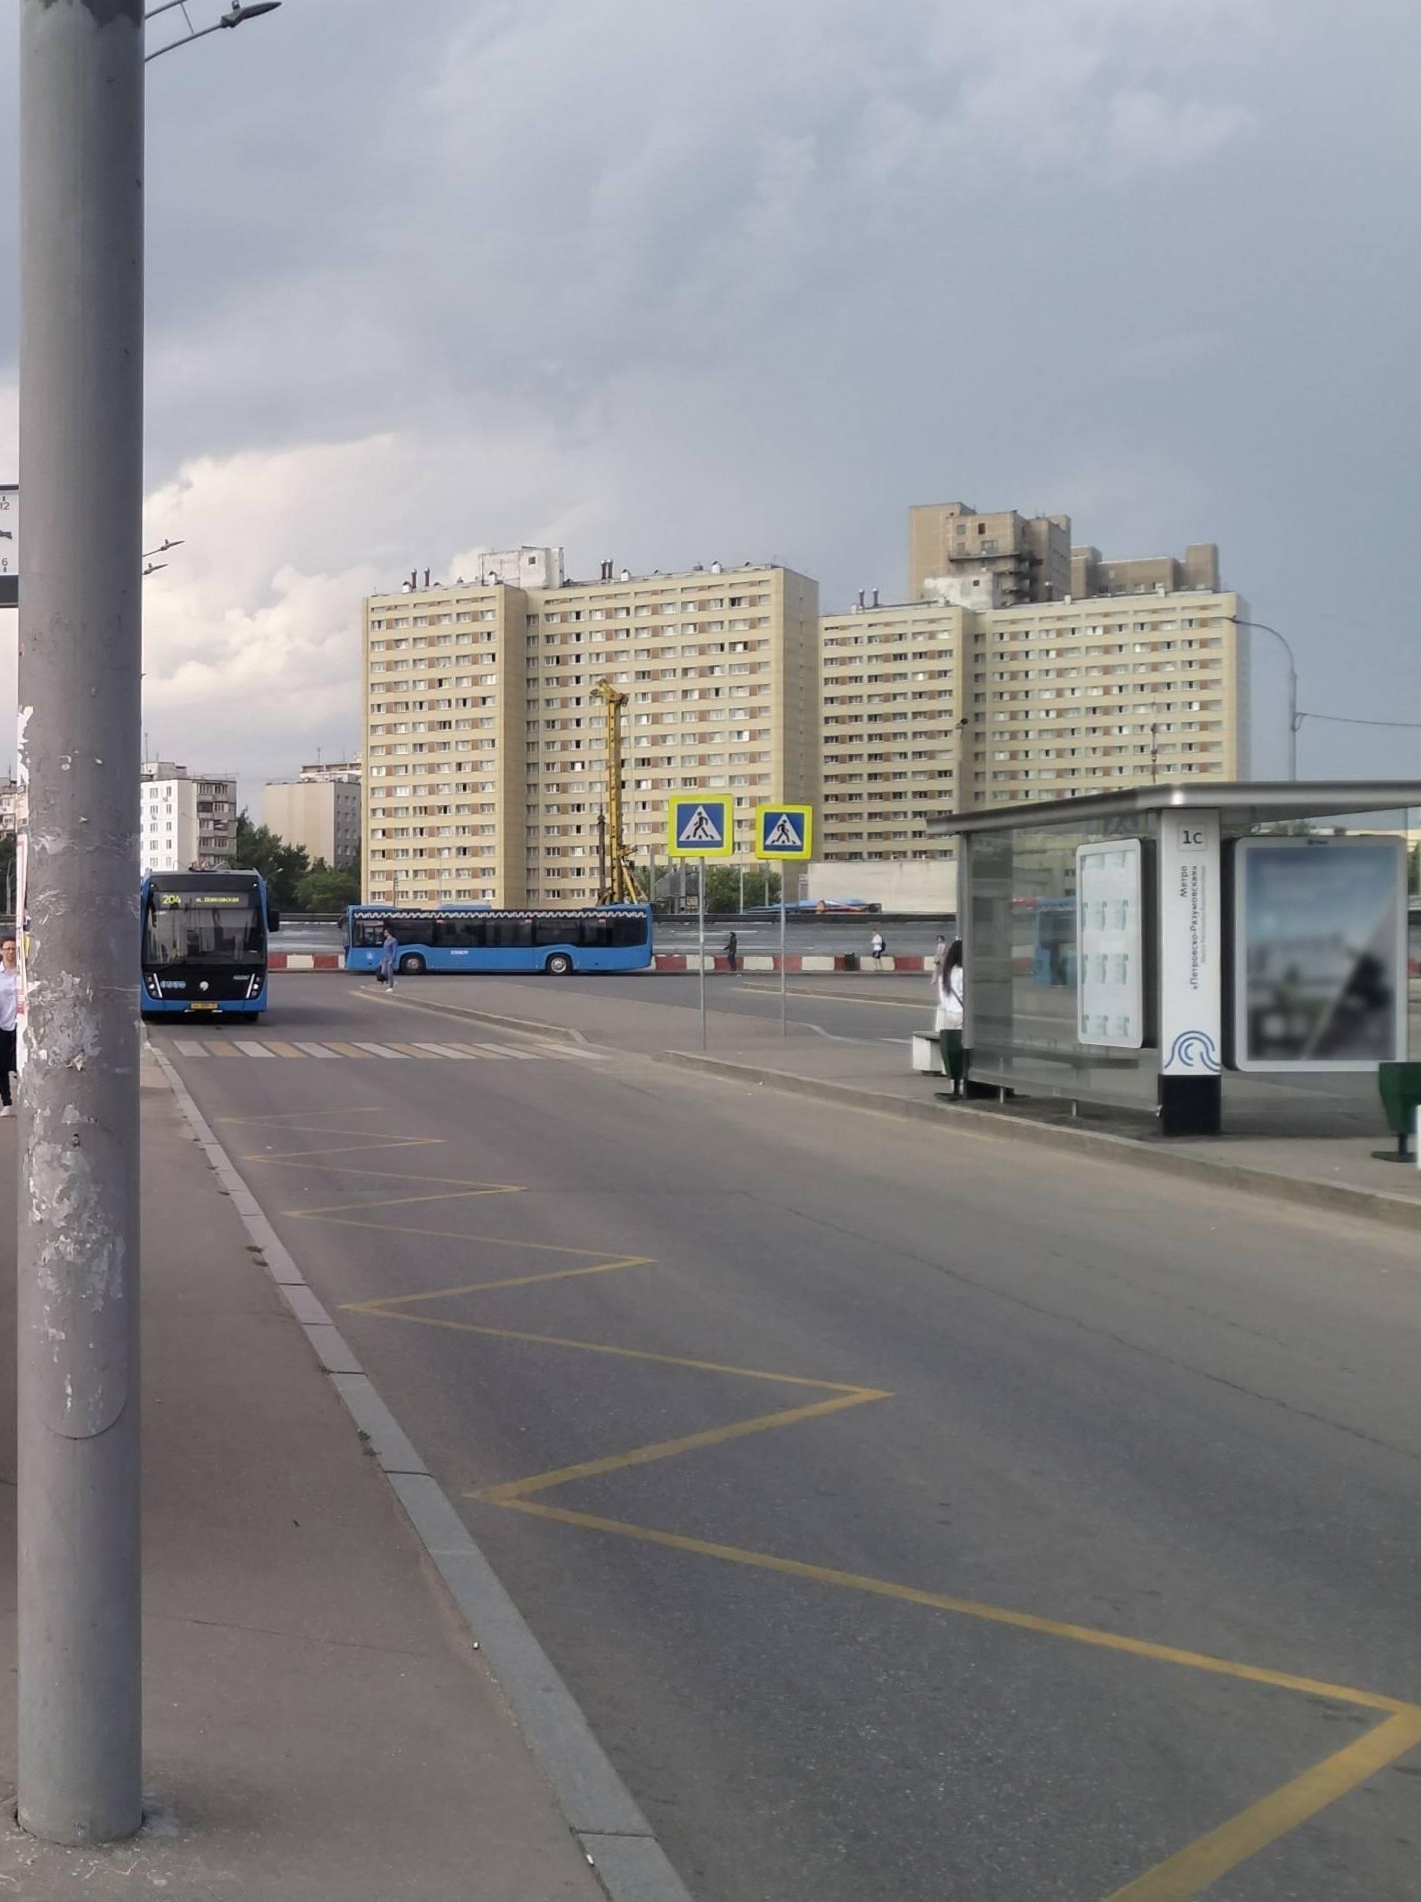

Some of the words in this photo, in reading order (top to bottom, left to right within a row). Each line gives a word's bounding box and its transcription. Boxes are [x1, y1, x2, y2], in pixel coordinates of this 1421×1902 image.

[0, 502, 10, 510] 12
[2, 558, 8, 566] 6
[1180, 866, 1188, 897] Метро
